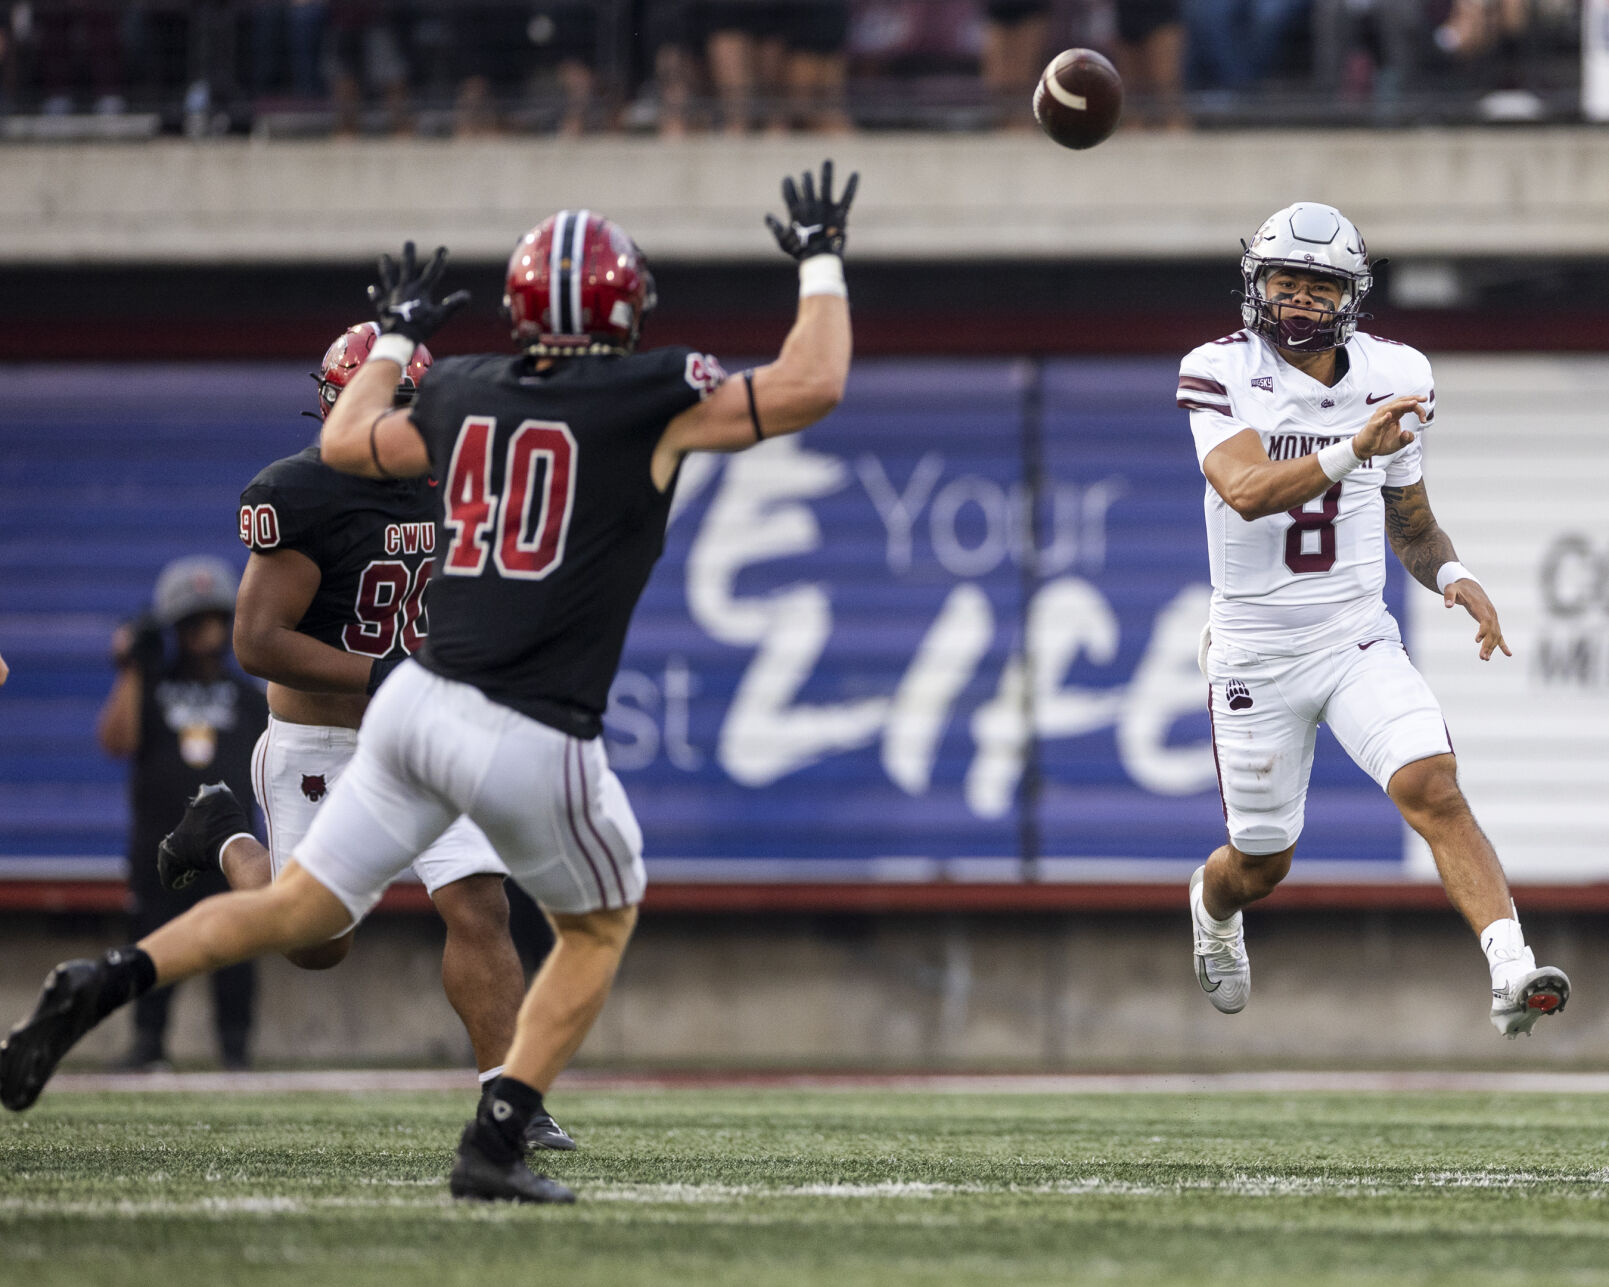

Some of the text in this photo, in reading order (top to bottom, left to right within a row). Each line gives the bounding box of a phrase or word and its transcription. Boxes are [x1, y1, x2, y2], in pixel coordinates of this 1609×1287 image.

[1267, 434, 1374, 469] MONT
[239, 503, 281, 548] 90
[444, 416, 578, 580] 40
[852, 450, 1128, 577] Your
[1283, 480, 1343, 576] 8
[384, 521, 436, 555] CWU
